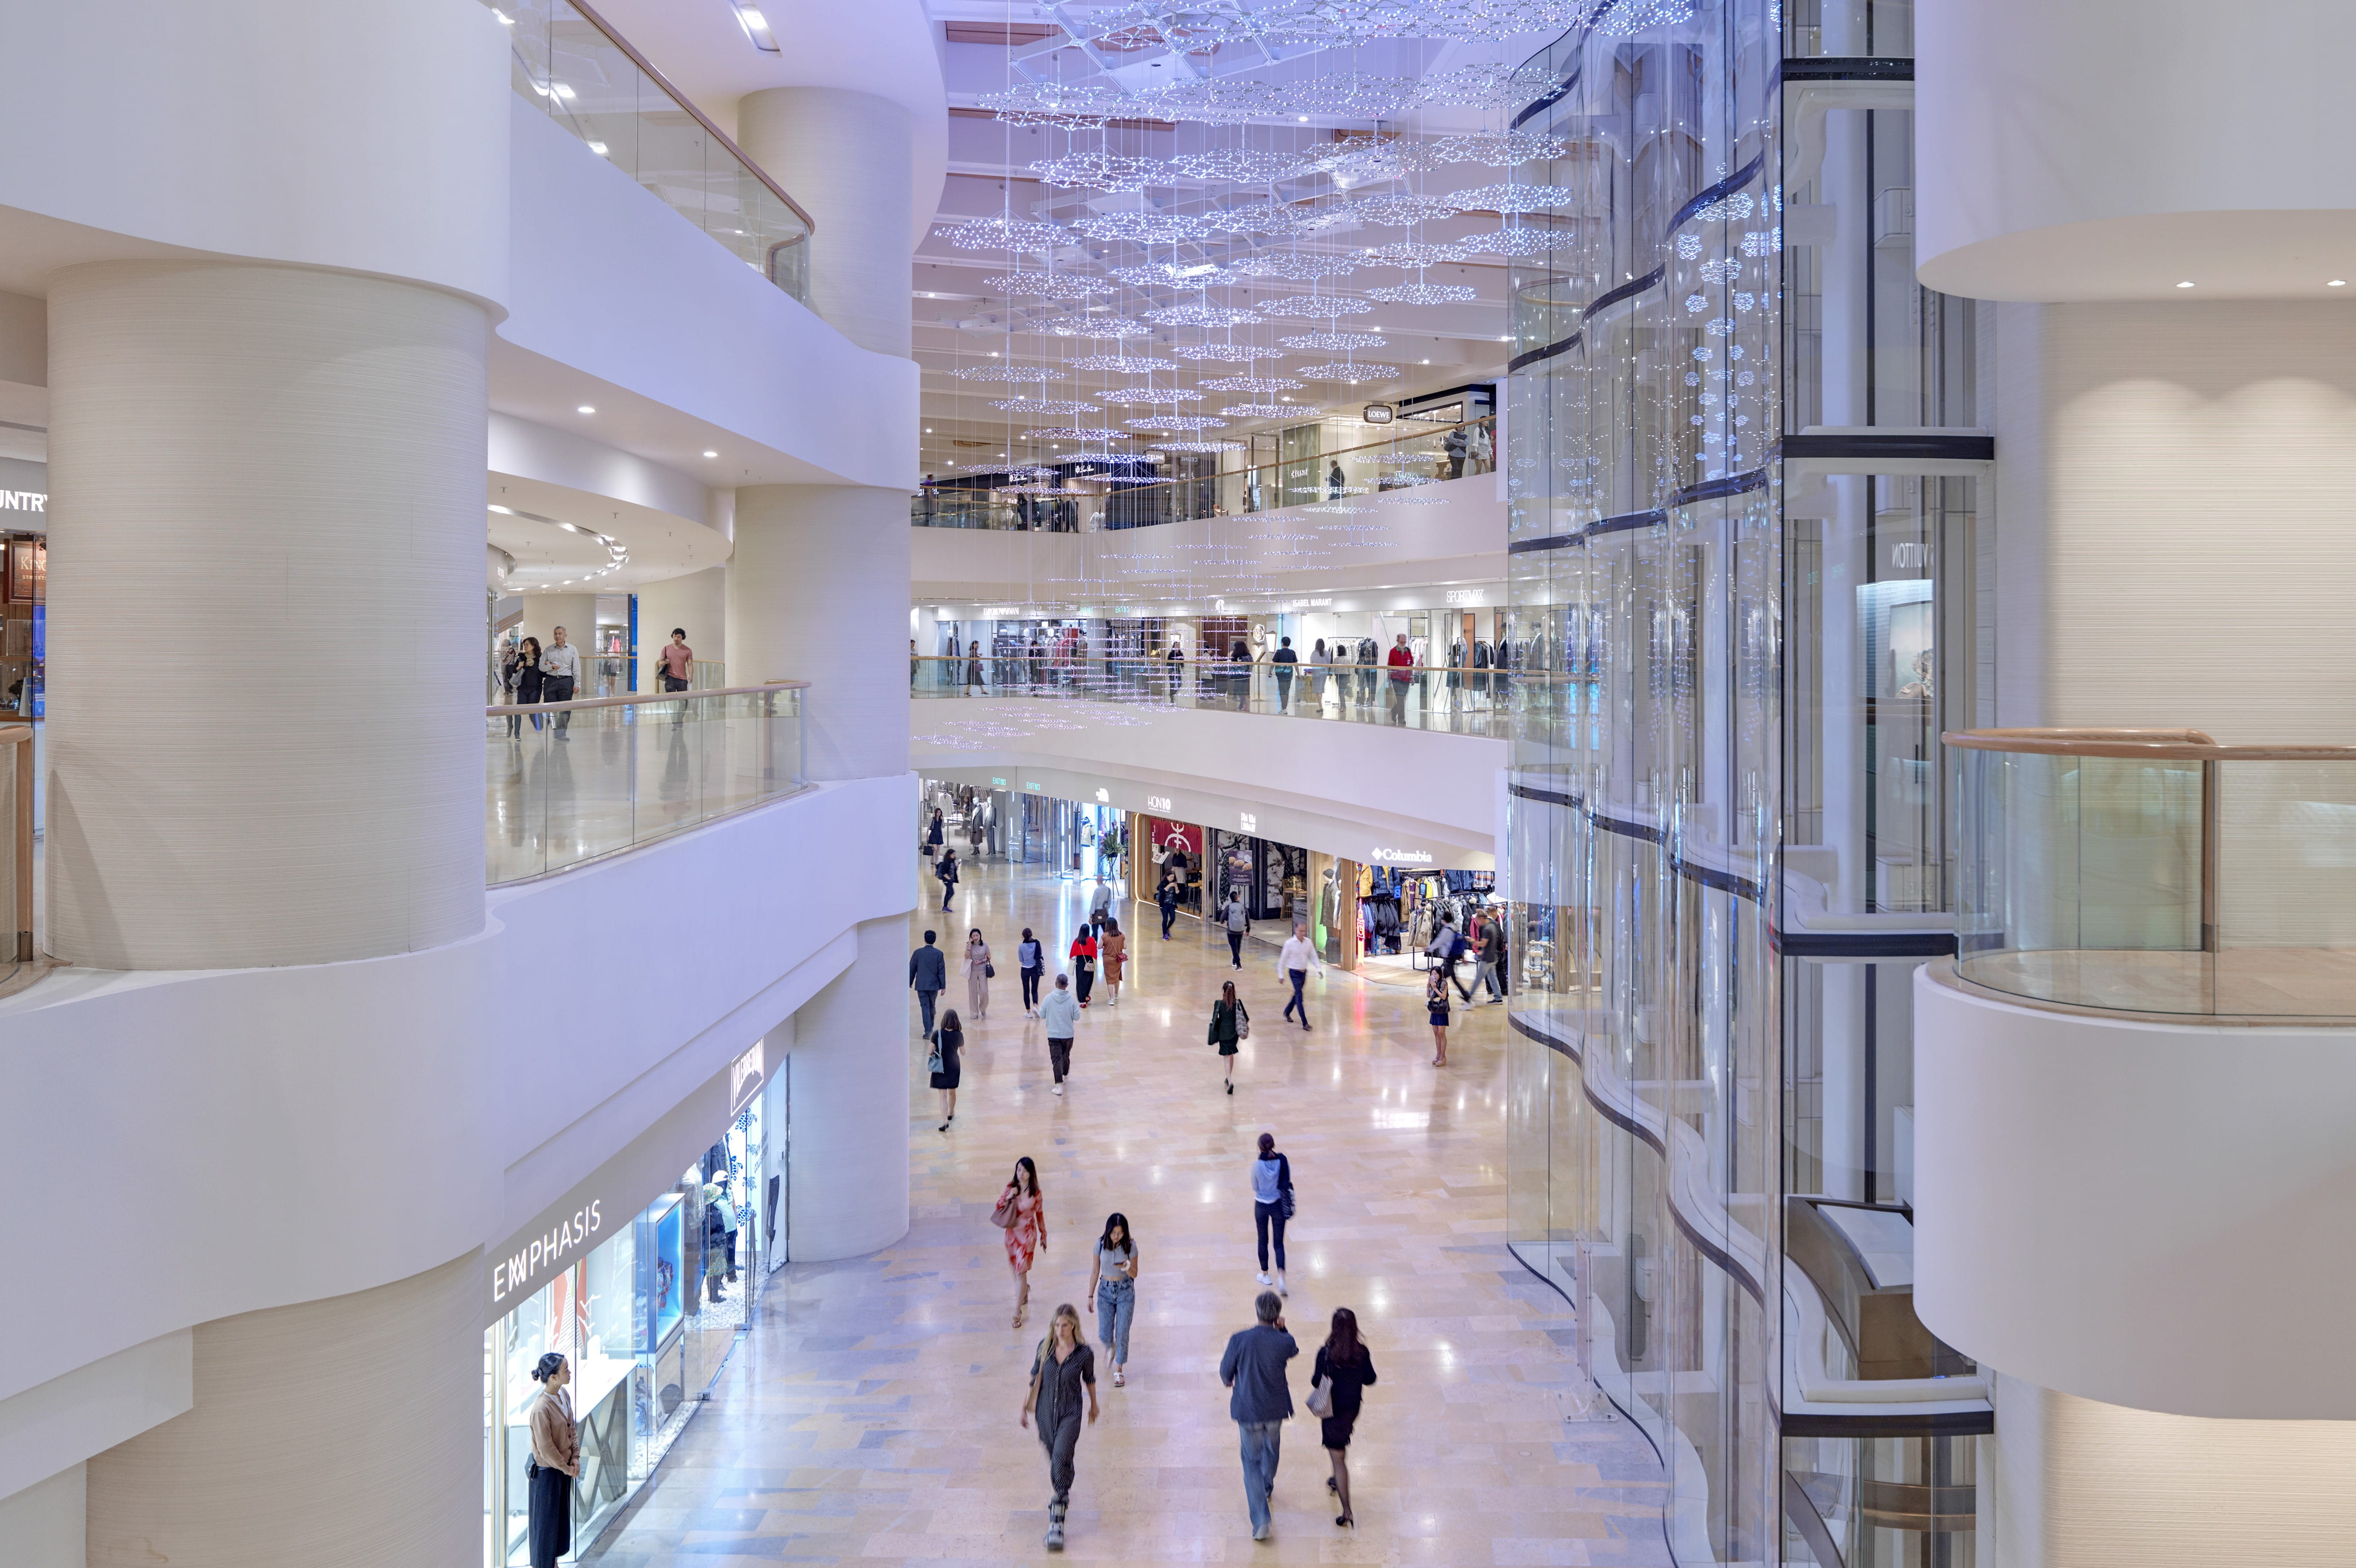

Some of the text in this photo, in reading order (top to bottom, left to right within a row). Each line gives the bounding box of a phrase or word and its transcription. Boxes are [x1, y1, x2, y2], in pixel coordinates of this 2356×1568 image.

[1291, 468, 1308, 478] CELINE
[0, 490, 47, 512] NTR
[1310, 598, 1332, 607] MARANT
[1446, 589, 1484, 603] SPORTMAX
[992, 777, 1000, 785] EXIT
[1383, 848, 1432, 863] Columbia
[732, 1038, 762, 1108] VILEBREQUIN
[494, 1199, 600, 1302] EMPHASIS
